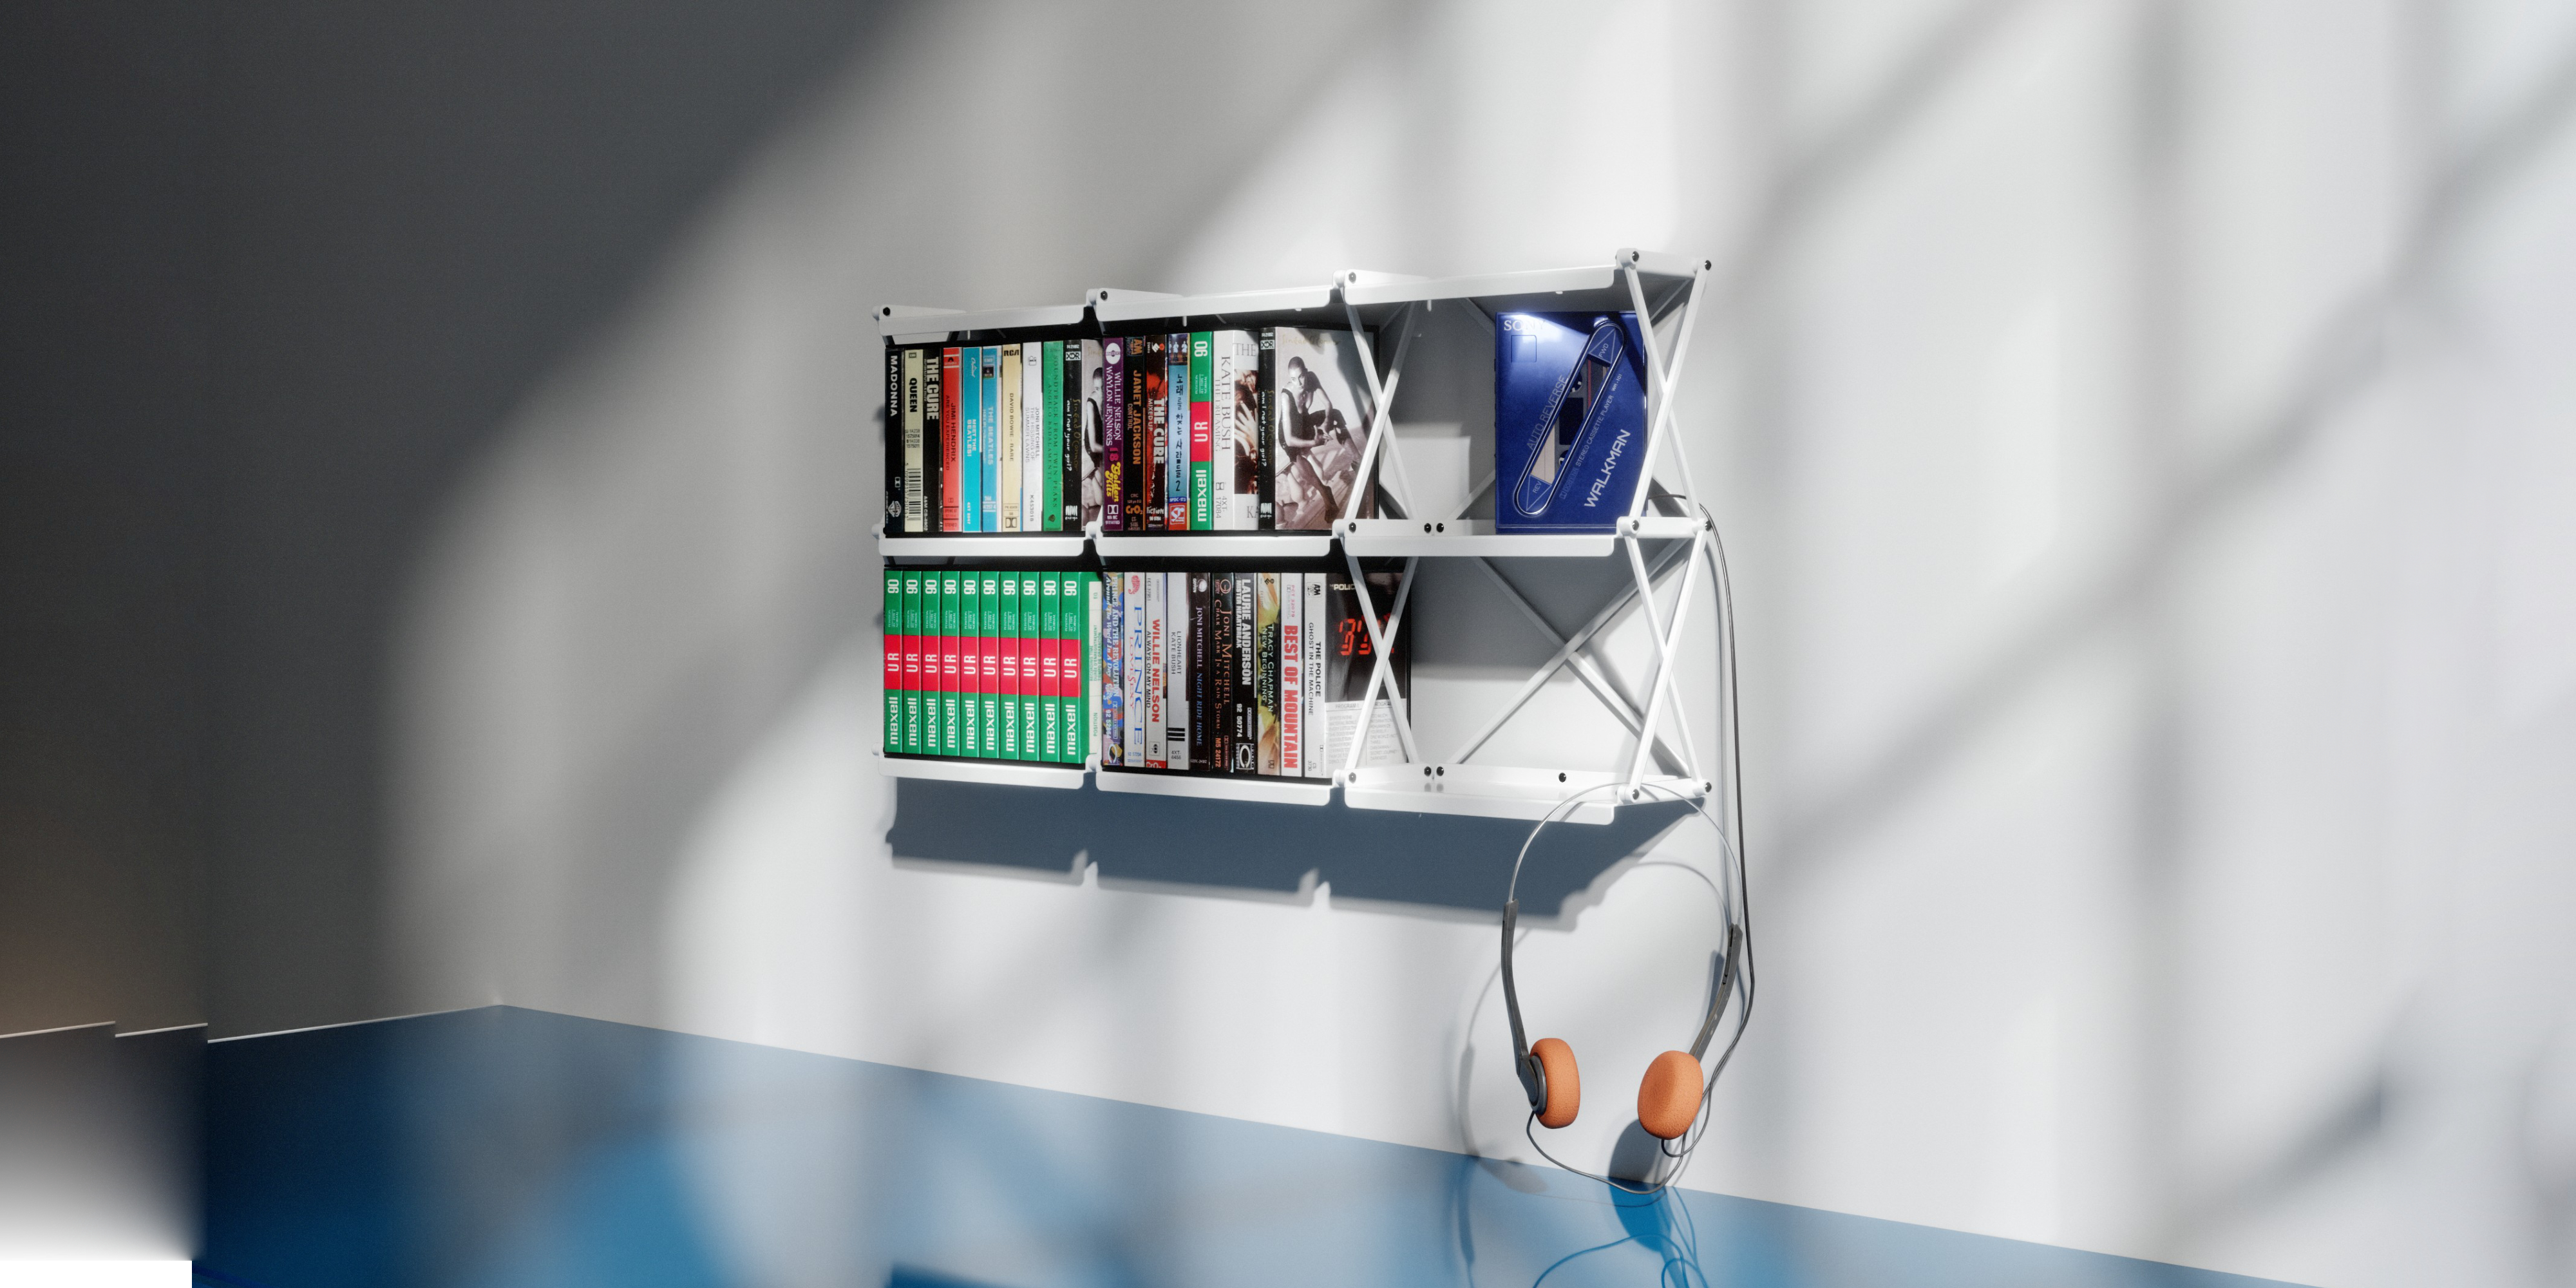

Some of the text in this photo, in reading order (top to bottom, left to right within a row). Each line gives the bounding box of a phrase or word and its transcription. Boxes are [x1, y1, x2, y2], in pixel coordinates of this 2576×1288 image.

[1504, 319, 1546, 331] SONY
[1194, 341, 1209, 357] 90
[1233, 343, 1256, 357] THE
[1598, 343, 1609, 358] FWD
[909, 377, 918, 413] QUEEN
[926, 356, 940, 421] THE CURE
[1221, 356, 1231, 451] KATE BUSH
[1261, 391, 1266, 404] am
[1066, 400, 1070, 412] am
[1113, 406, 1122, 440] NELSON
[1133, 370, 1142, 464] JANET JACKSON
[1526, 374, 1569, 451] AUTO REVERSE
[1104, 404, 1113, 446] JENNINGS
[1148, 422, 1153, 431] UP
[1153, 397, 1165, 464] THE CURE
[1575, 444, 1589, 467] STEREO
[1586, 415, 1604, 445] CASSETTE
[1600, 395, 1615, 416] PLAYER
[1031, 451, 1035, 461] OF
[1584, 429, 1631, 507] WALKMAN
[1104, 470, 1113, 497] Hits
[1110, 462, 1121, 502] Golden
[1175, 480, 1181, 491] 2
[1195, 469, 1207, 522] maxell
[1532, 480, 1542, 494] REV
[887, 579, 899, 594] 90
[1064, 580, 1077, 596] 90
[1241, 578, 1251, 685] LAURIE ANDERSON
[1106, 644, 1112, 654] In
[1215, 659, 1222, 668] IN
[1220, 609, 1233, 705] JONI MITCHELL
[1134, 604, 1142, 744] PRINCE
[1146, 663, 1151, 674] ON
[1146, 676, 1151, 687] MY
[1151, 668, 1160, 723] NELSON
[1236, 703, 1243, 712] 92
[1283, 625, 1298, 768] BEST OF MOUNTAIN
[889, 697, 898, 744] maxell
[1065, 705, 1076, 755] maxell
